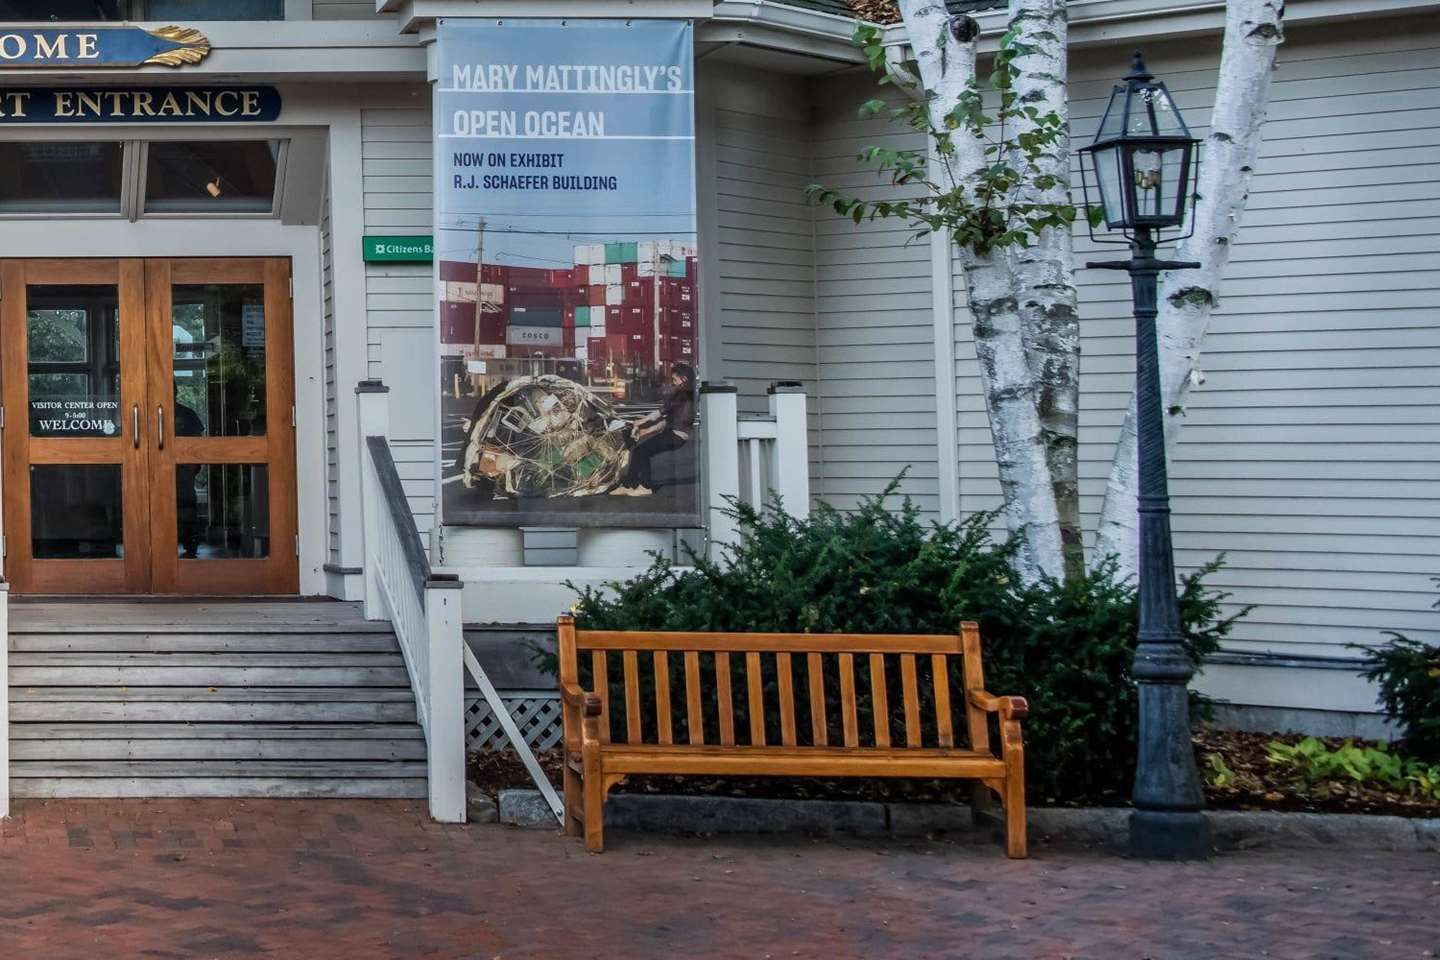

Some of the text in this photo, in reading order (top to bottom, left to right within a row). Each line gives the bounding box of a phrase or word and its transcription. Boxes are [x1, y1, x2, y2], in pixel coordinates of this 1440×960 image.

[452, 64, 682, 91] MARY MATTINGLY’S
[54, 91, 262, 118] ENTRANCE
[453, 110, 605, 138] OPEN OCEAN
[453, 153, 564, 168] NOW ON EXHIBIT
[453, 175, 618, 190] R.J. SCHAEFER BUILDING
[386, 245, 423, 254] Citizens
[32, 401, 118, 409] VISITOR CENTER OPEN
